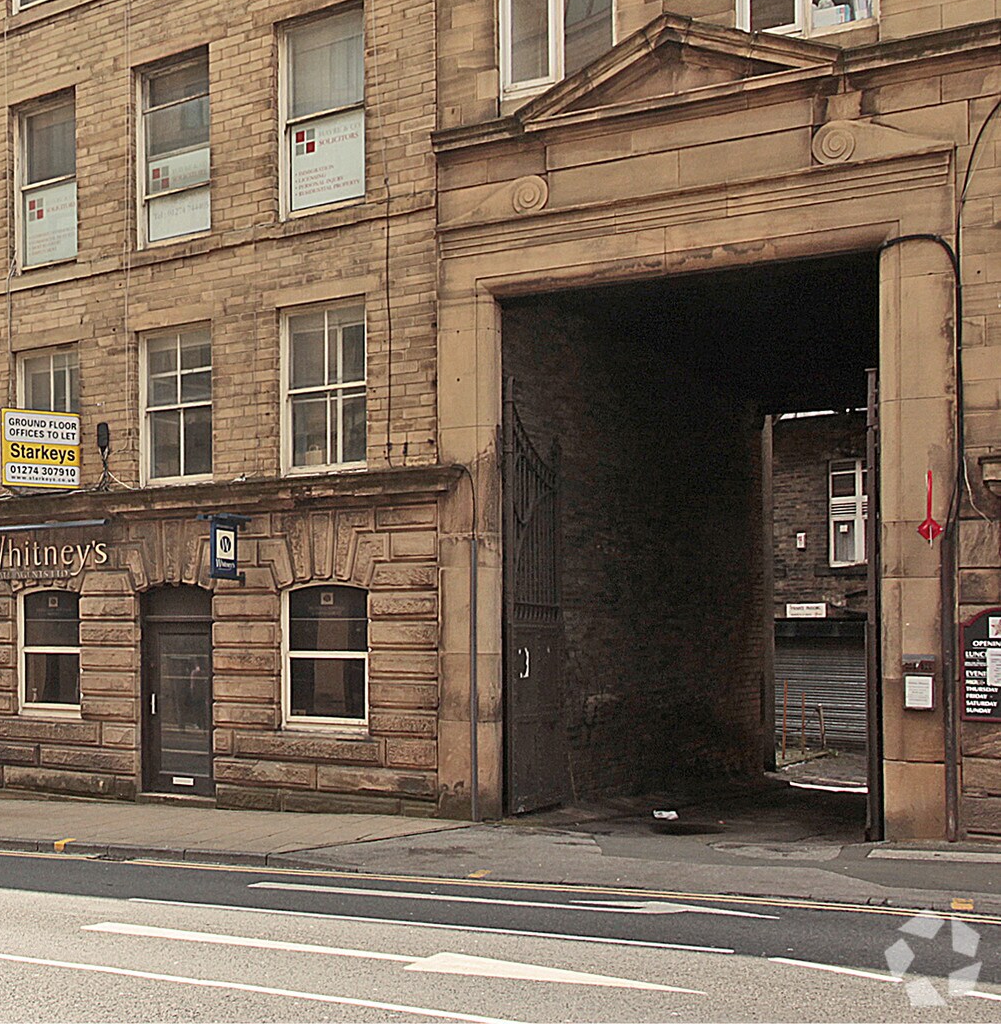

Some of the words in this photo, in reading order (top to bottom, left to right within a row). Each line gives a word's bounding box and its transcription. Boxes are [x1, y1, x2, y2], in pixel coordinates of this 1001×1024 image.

[319, 132, 359, 146] SOLICITORS
[333, 178, 360, 190] PROPERTY
[8, 417, 47, 428] GROUND
[49, 421, 77, 430] FLOOR
[9, 428, 45, 438] OFFICES
[47, 431, 59, 439] TO
[61, 432, 76, 440] LET
[10, 442, 76, 464] Starkeys
[10, 465, 39, 475] 01274
[41, 467, 76, 477] 307910
[11, 475, 75, 483] www.starkeys.co.uk
[965, 651, 986, 659] LUNC
